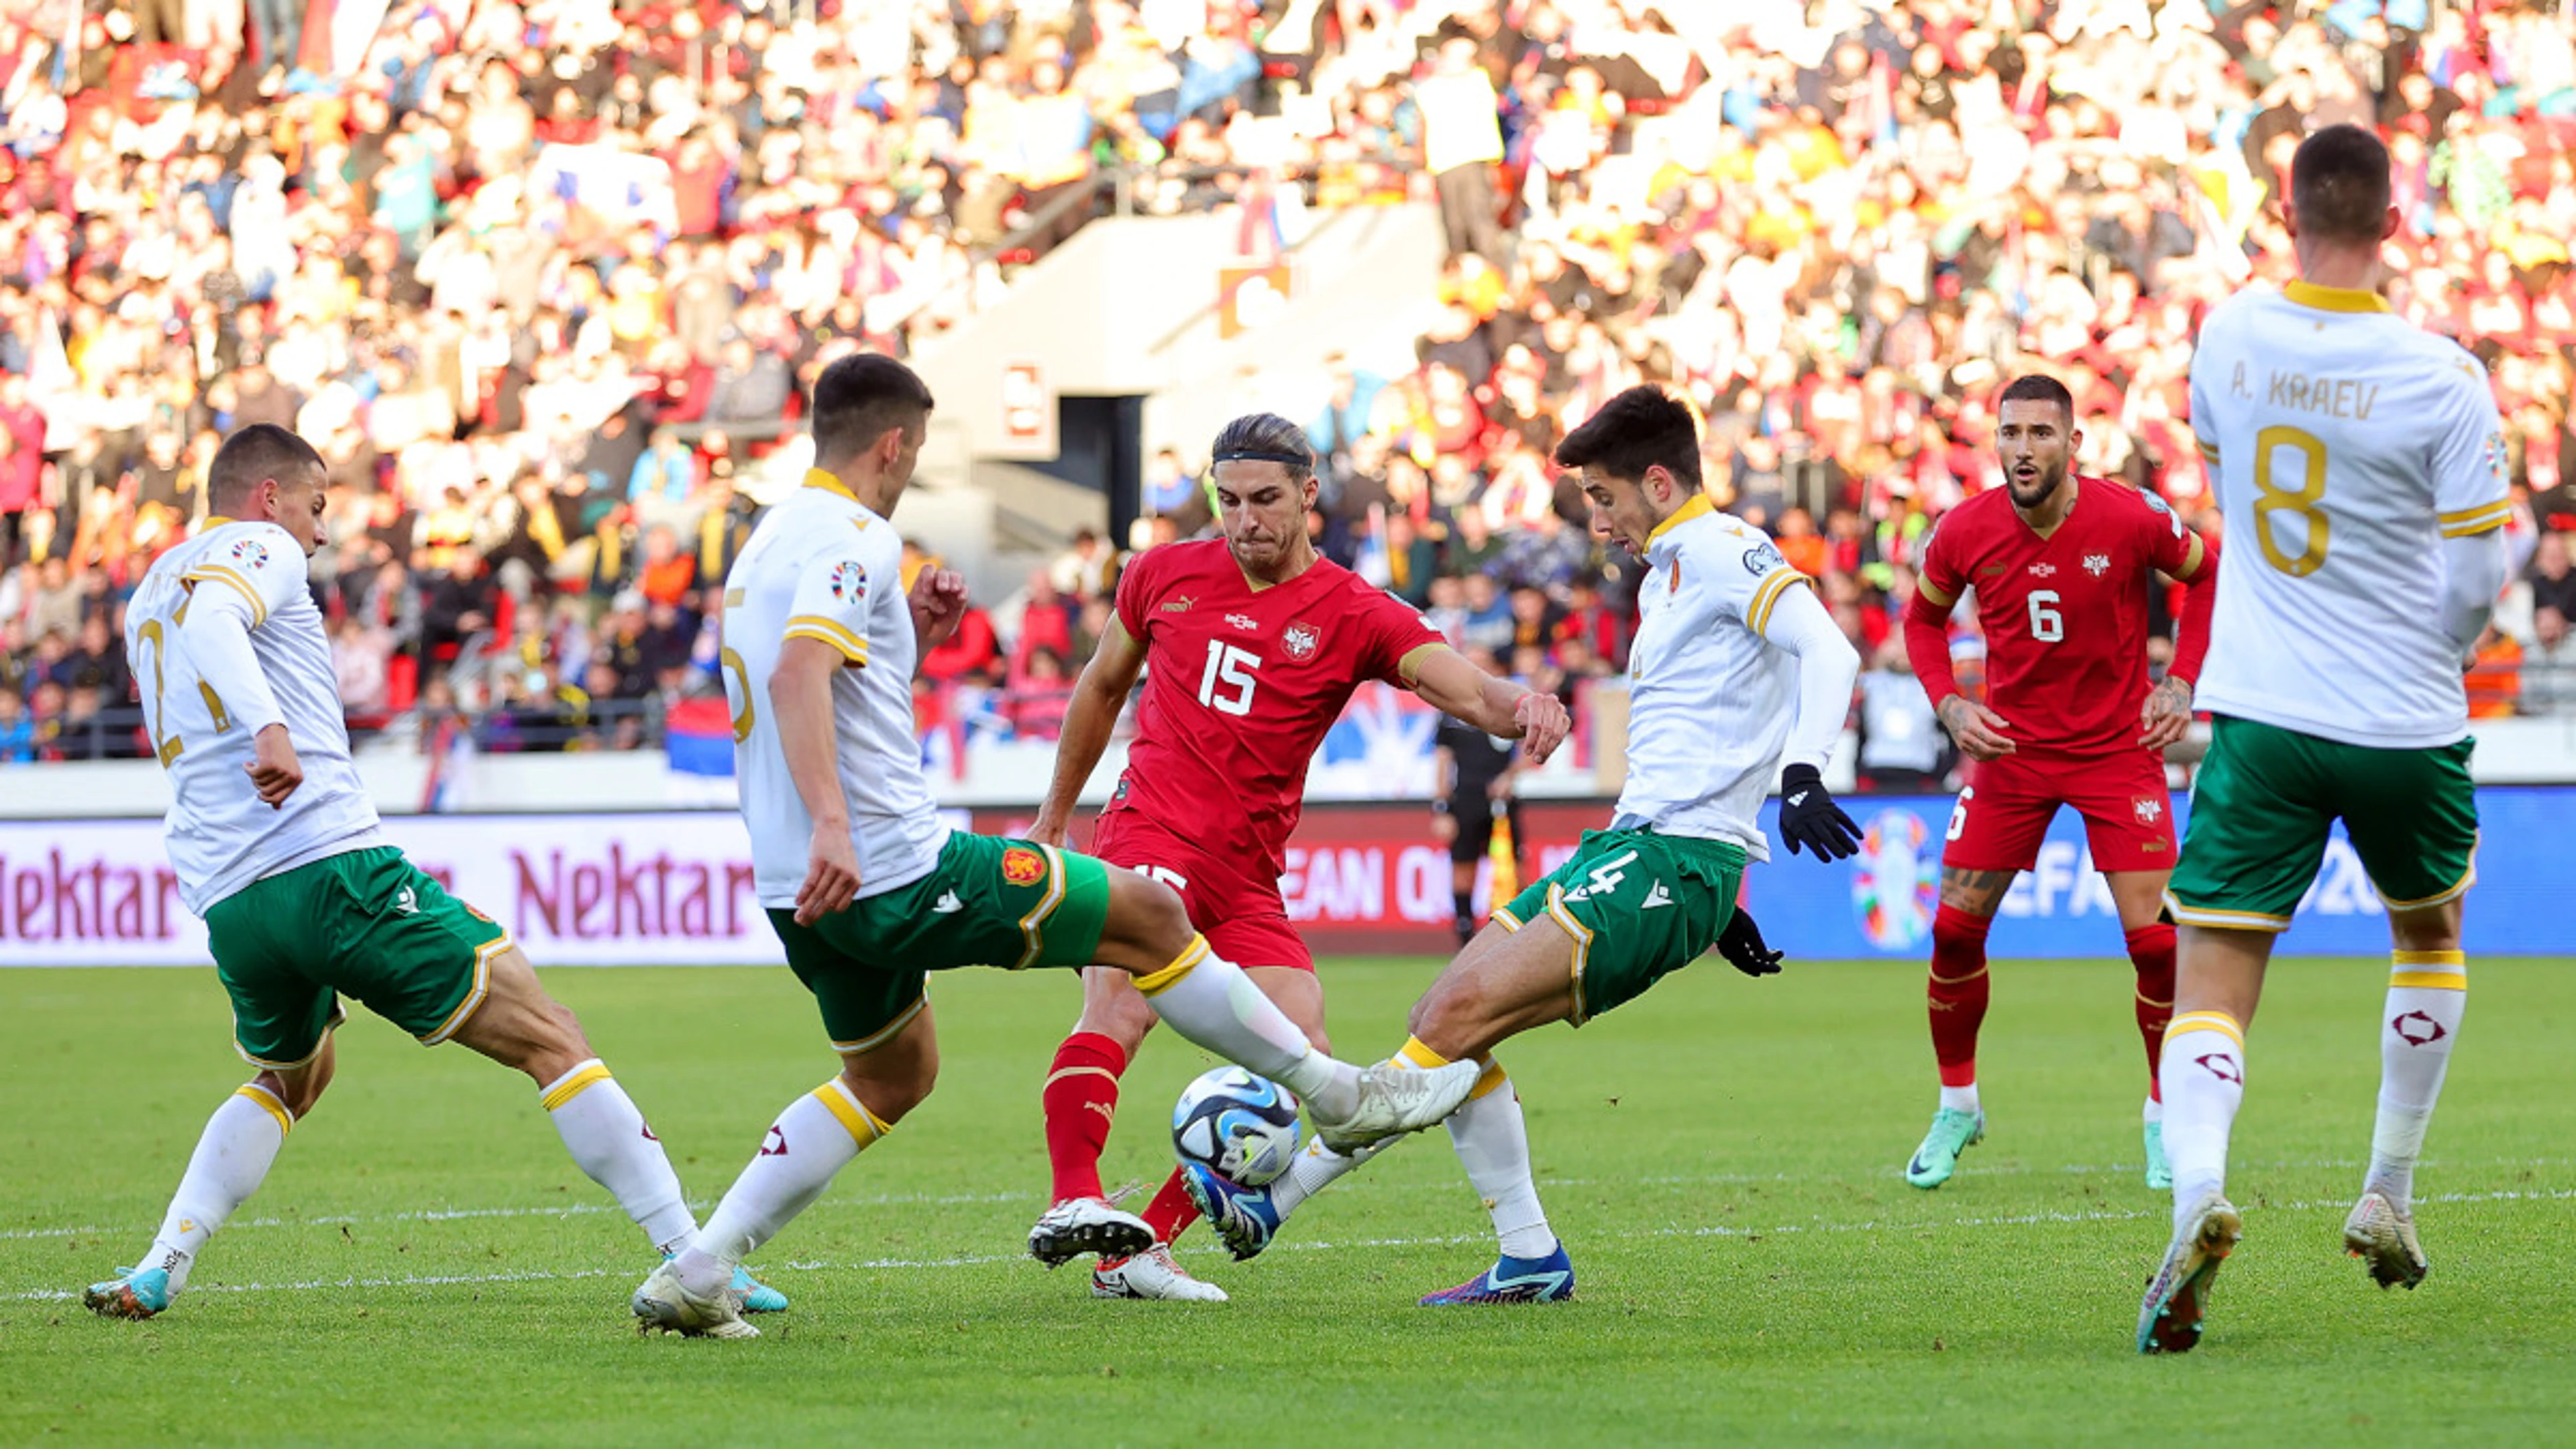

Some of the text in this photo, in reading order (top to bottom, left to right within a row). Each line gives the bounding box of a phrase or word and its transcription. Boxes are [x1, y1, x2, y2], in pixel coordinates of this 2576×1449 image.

[2231, 360, 2379, 421] A. KRAEV
[2253, 424, 2330, 578] 8
[2027, 589, 2064, 642] 6
[1197, 638, 1263, 716] 15
[1945, 785, 1974, 841] 6
[0, 849, 181, 941] ektar
[513, 843, 757, 940] Nektar
[1587, 849, 1638, 895] 4
